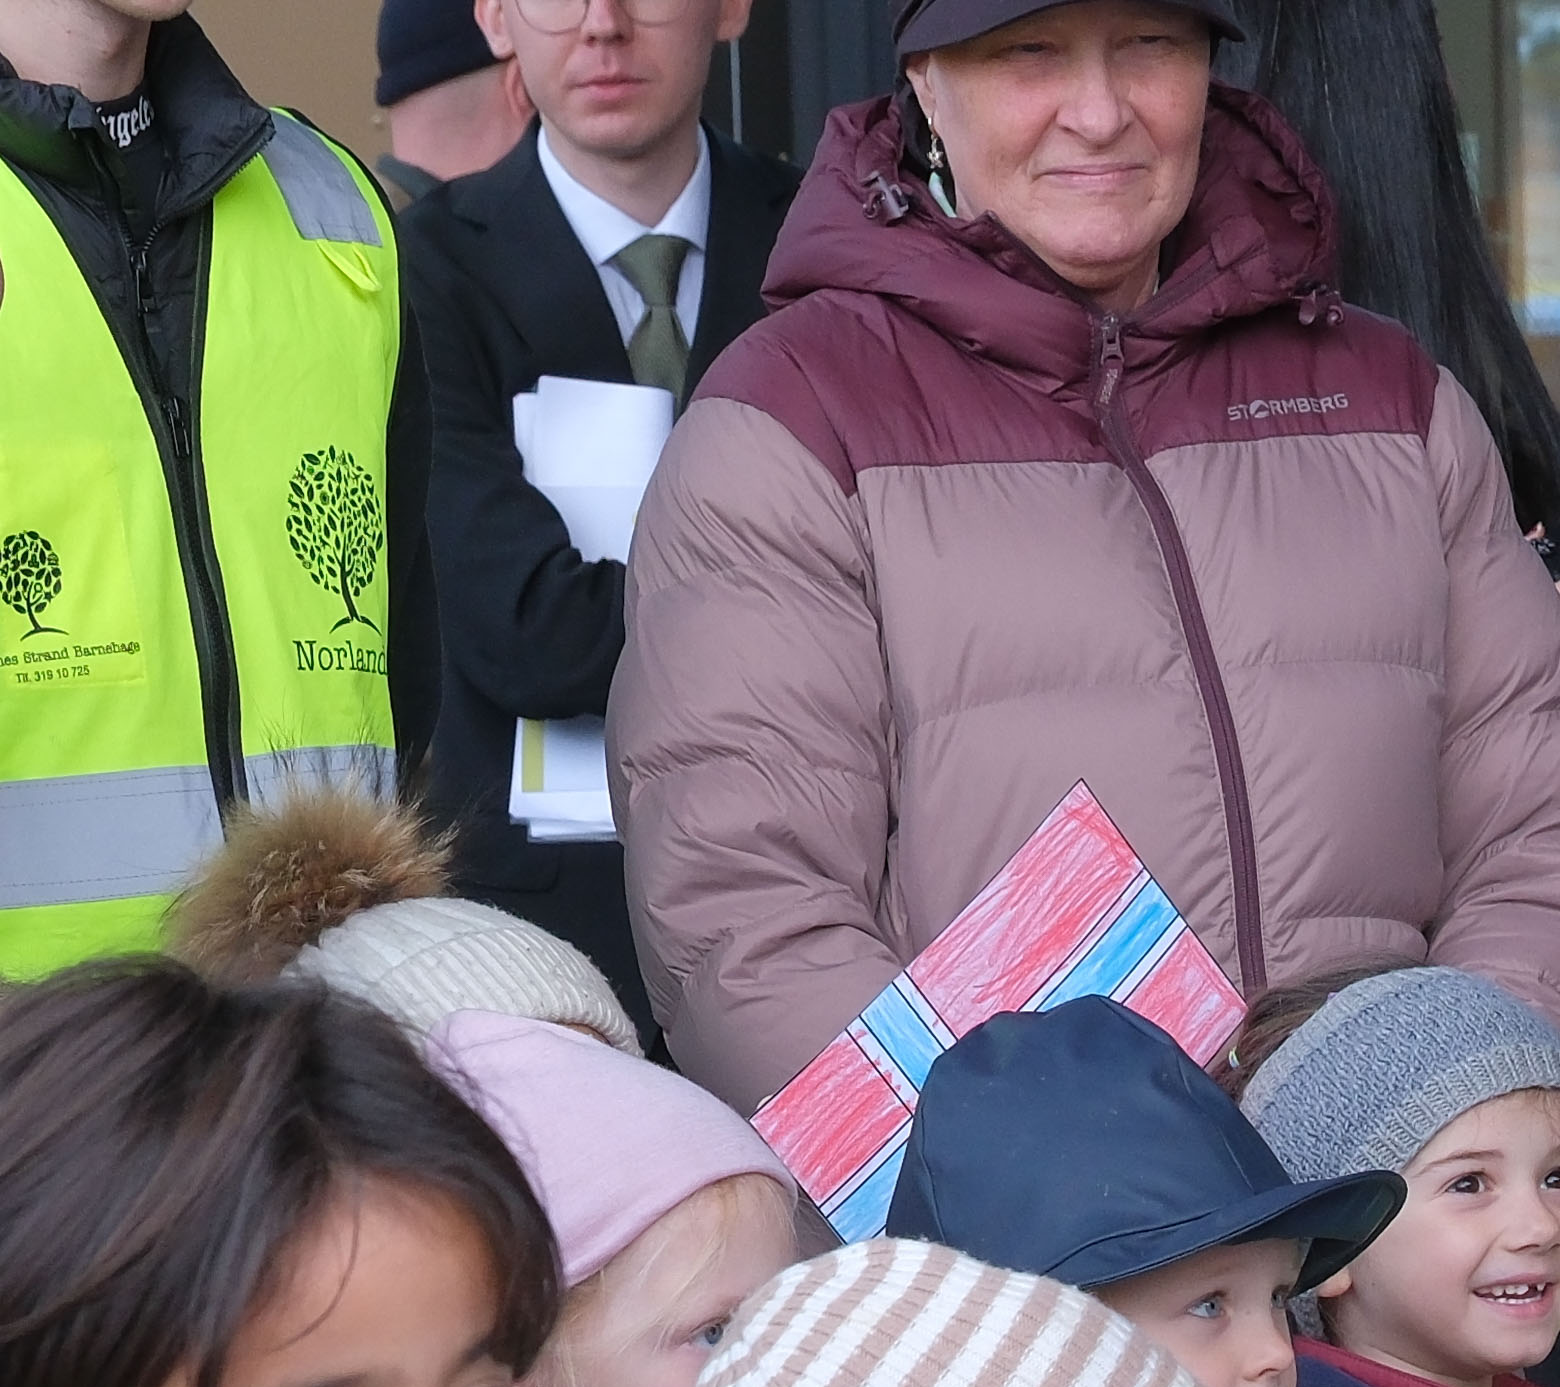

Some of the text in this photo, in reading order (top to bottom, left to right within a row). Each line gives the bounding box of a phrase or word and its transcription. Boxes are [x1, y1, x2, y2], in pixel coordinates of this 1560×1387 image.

[1227, 393, 1349, 421] STORMBERG
[23, 650, 70, 665] Strand
[73, 640, 141, 658] Barnehage
[34, 669, 54, 683] 319
[56, 668, 69, 680] 10
[71, 664, 90, 678] 725
